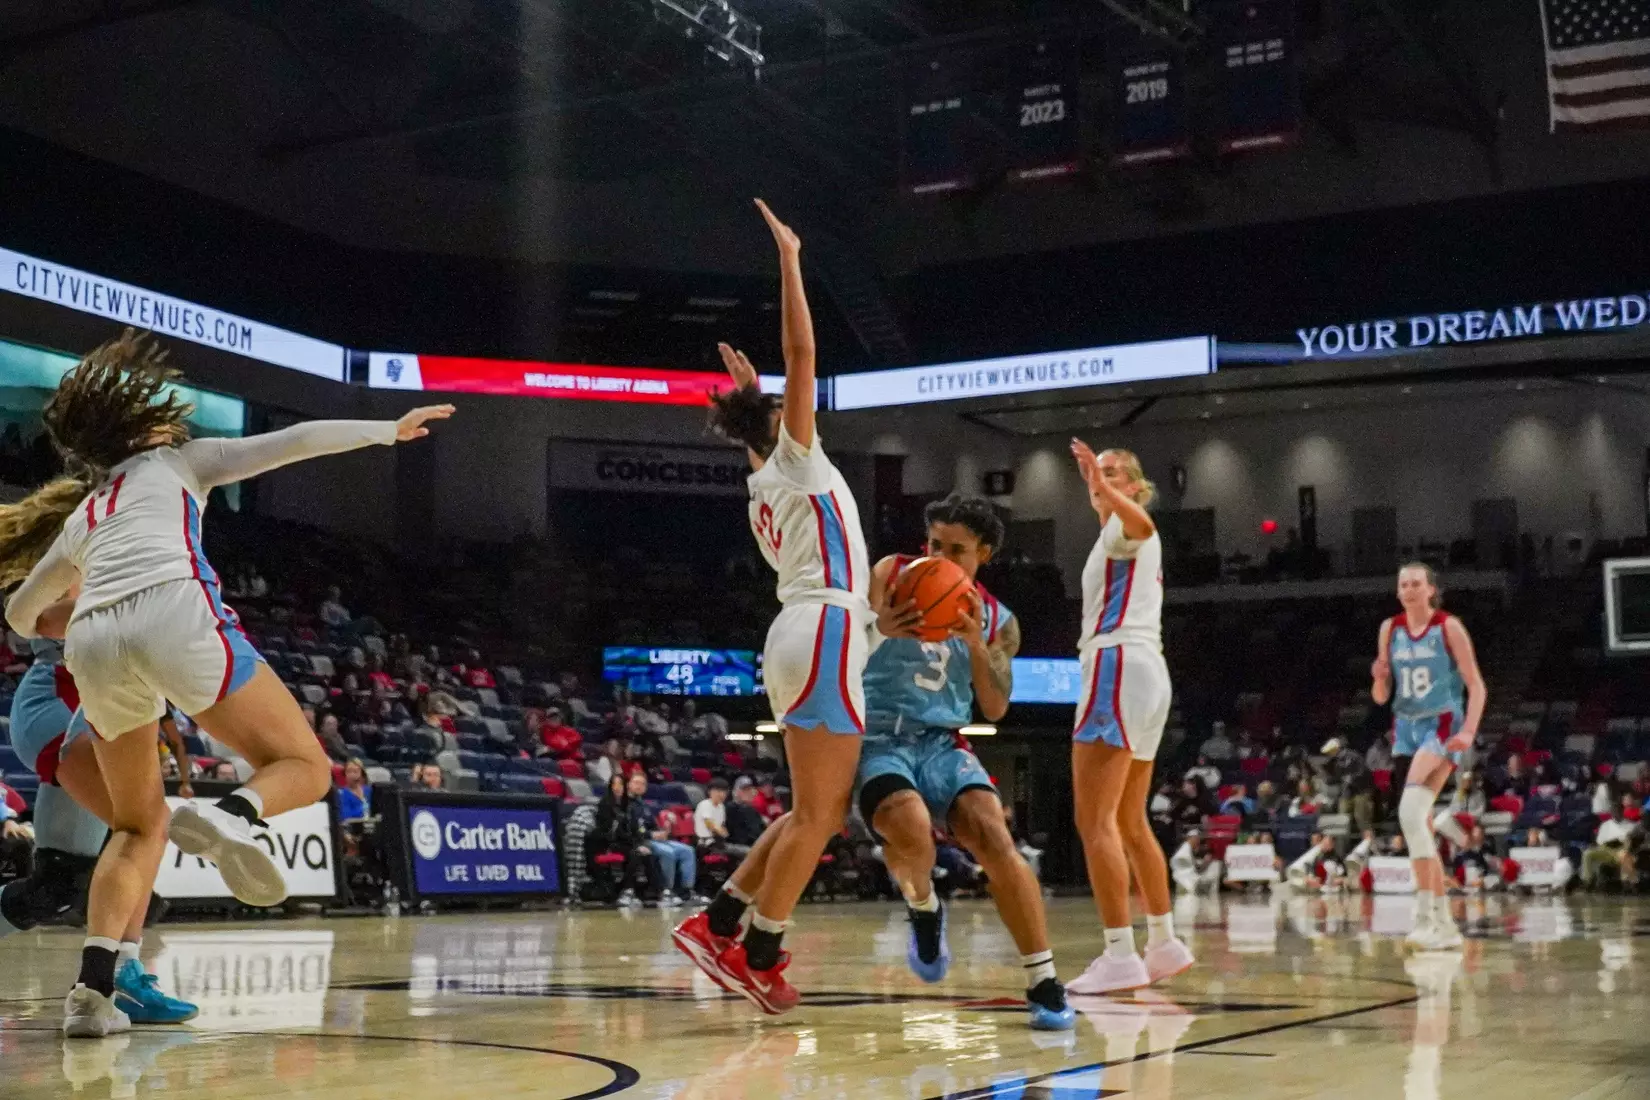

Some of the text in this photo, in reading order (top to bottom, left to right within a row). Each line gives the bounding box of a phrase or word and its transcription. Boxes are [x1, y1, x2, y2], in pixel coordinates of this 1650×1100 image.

[1126, 78, 1168, 104] 2019
[1020, 99, 1065, 127] 2023
[16, 261, 253, 352] CITYVIEWVENUES.COM
[1297, 292, 1650, 357] YOUR DREAM WED
[916, 357, 1114, 394] CITYVIEWVENUES.COM
[650, 649, 711, 665] LIBERTY
[914, 642, 951, 692] 3
[1400, 666, 1431, 699] 18
[444, 820, 556, 851] Carter Bank
